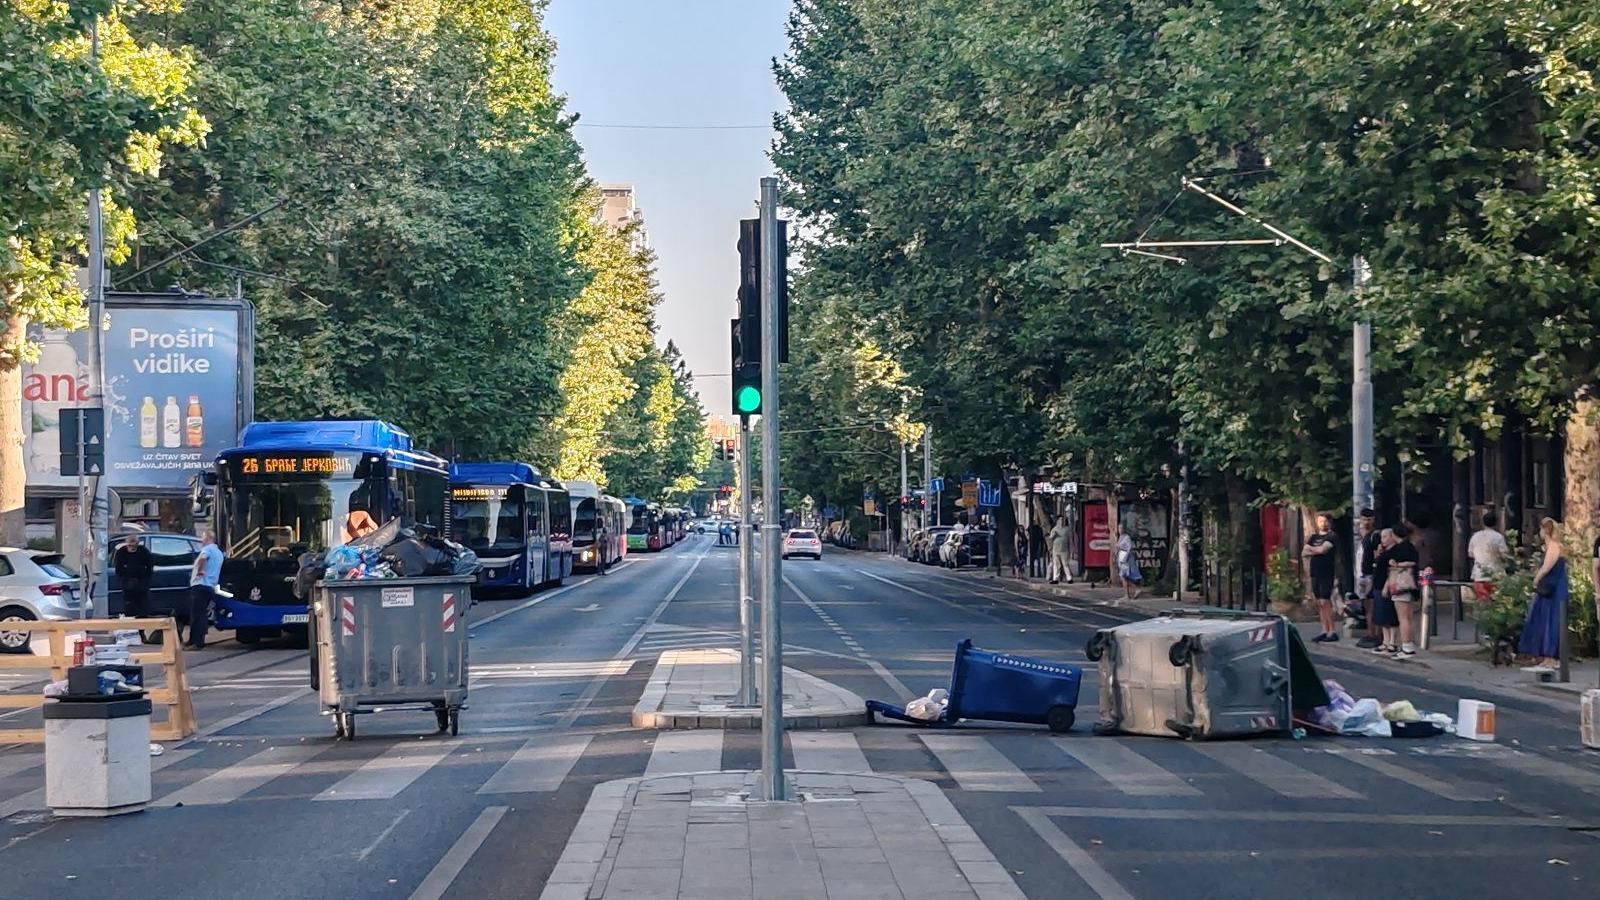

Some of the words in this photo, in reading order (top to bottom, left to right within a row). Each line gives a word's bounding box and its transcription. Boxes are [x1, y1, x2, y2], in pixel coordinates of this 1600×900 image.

[130, 327, 214, 348] Proširi
[133, 353, 210, 374] vidike
[156, 452, 180, 460] ČITAV
[242, 458, 259, 473] 26
[265, 458, 297, 472] БРАЂЕ
